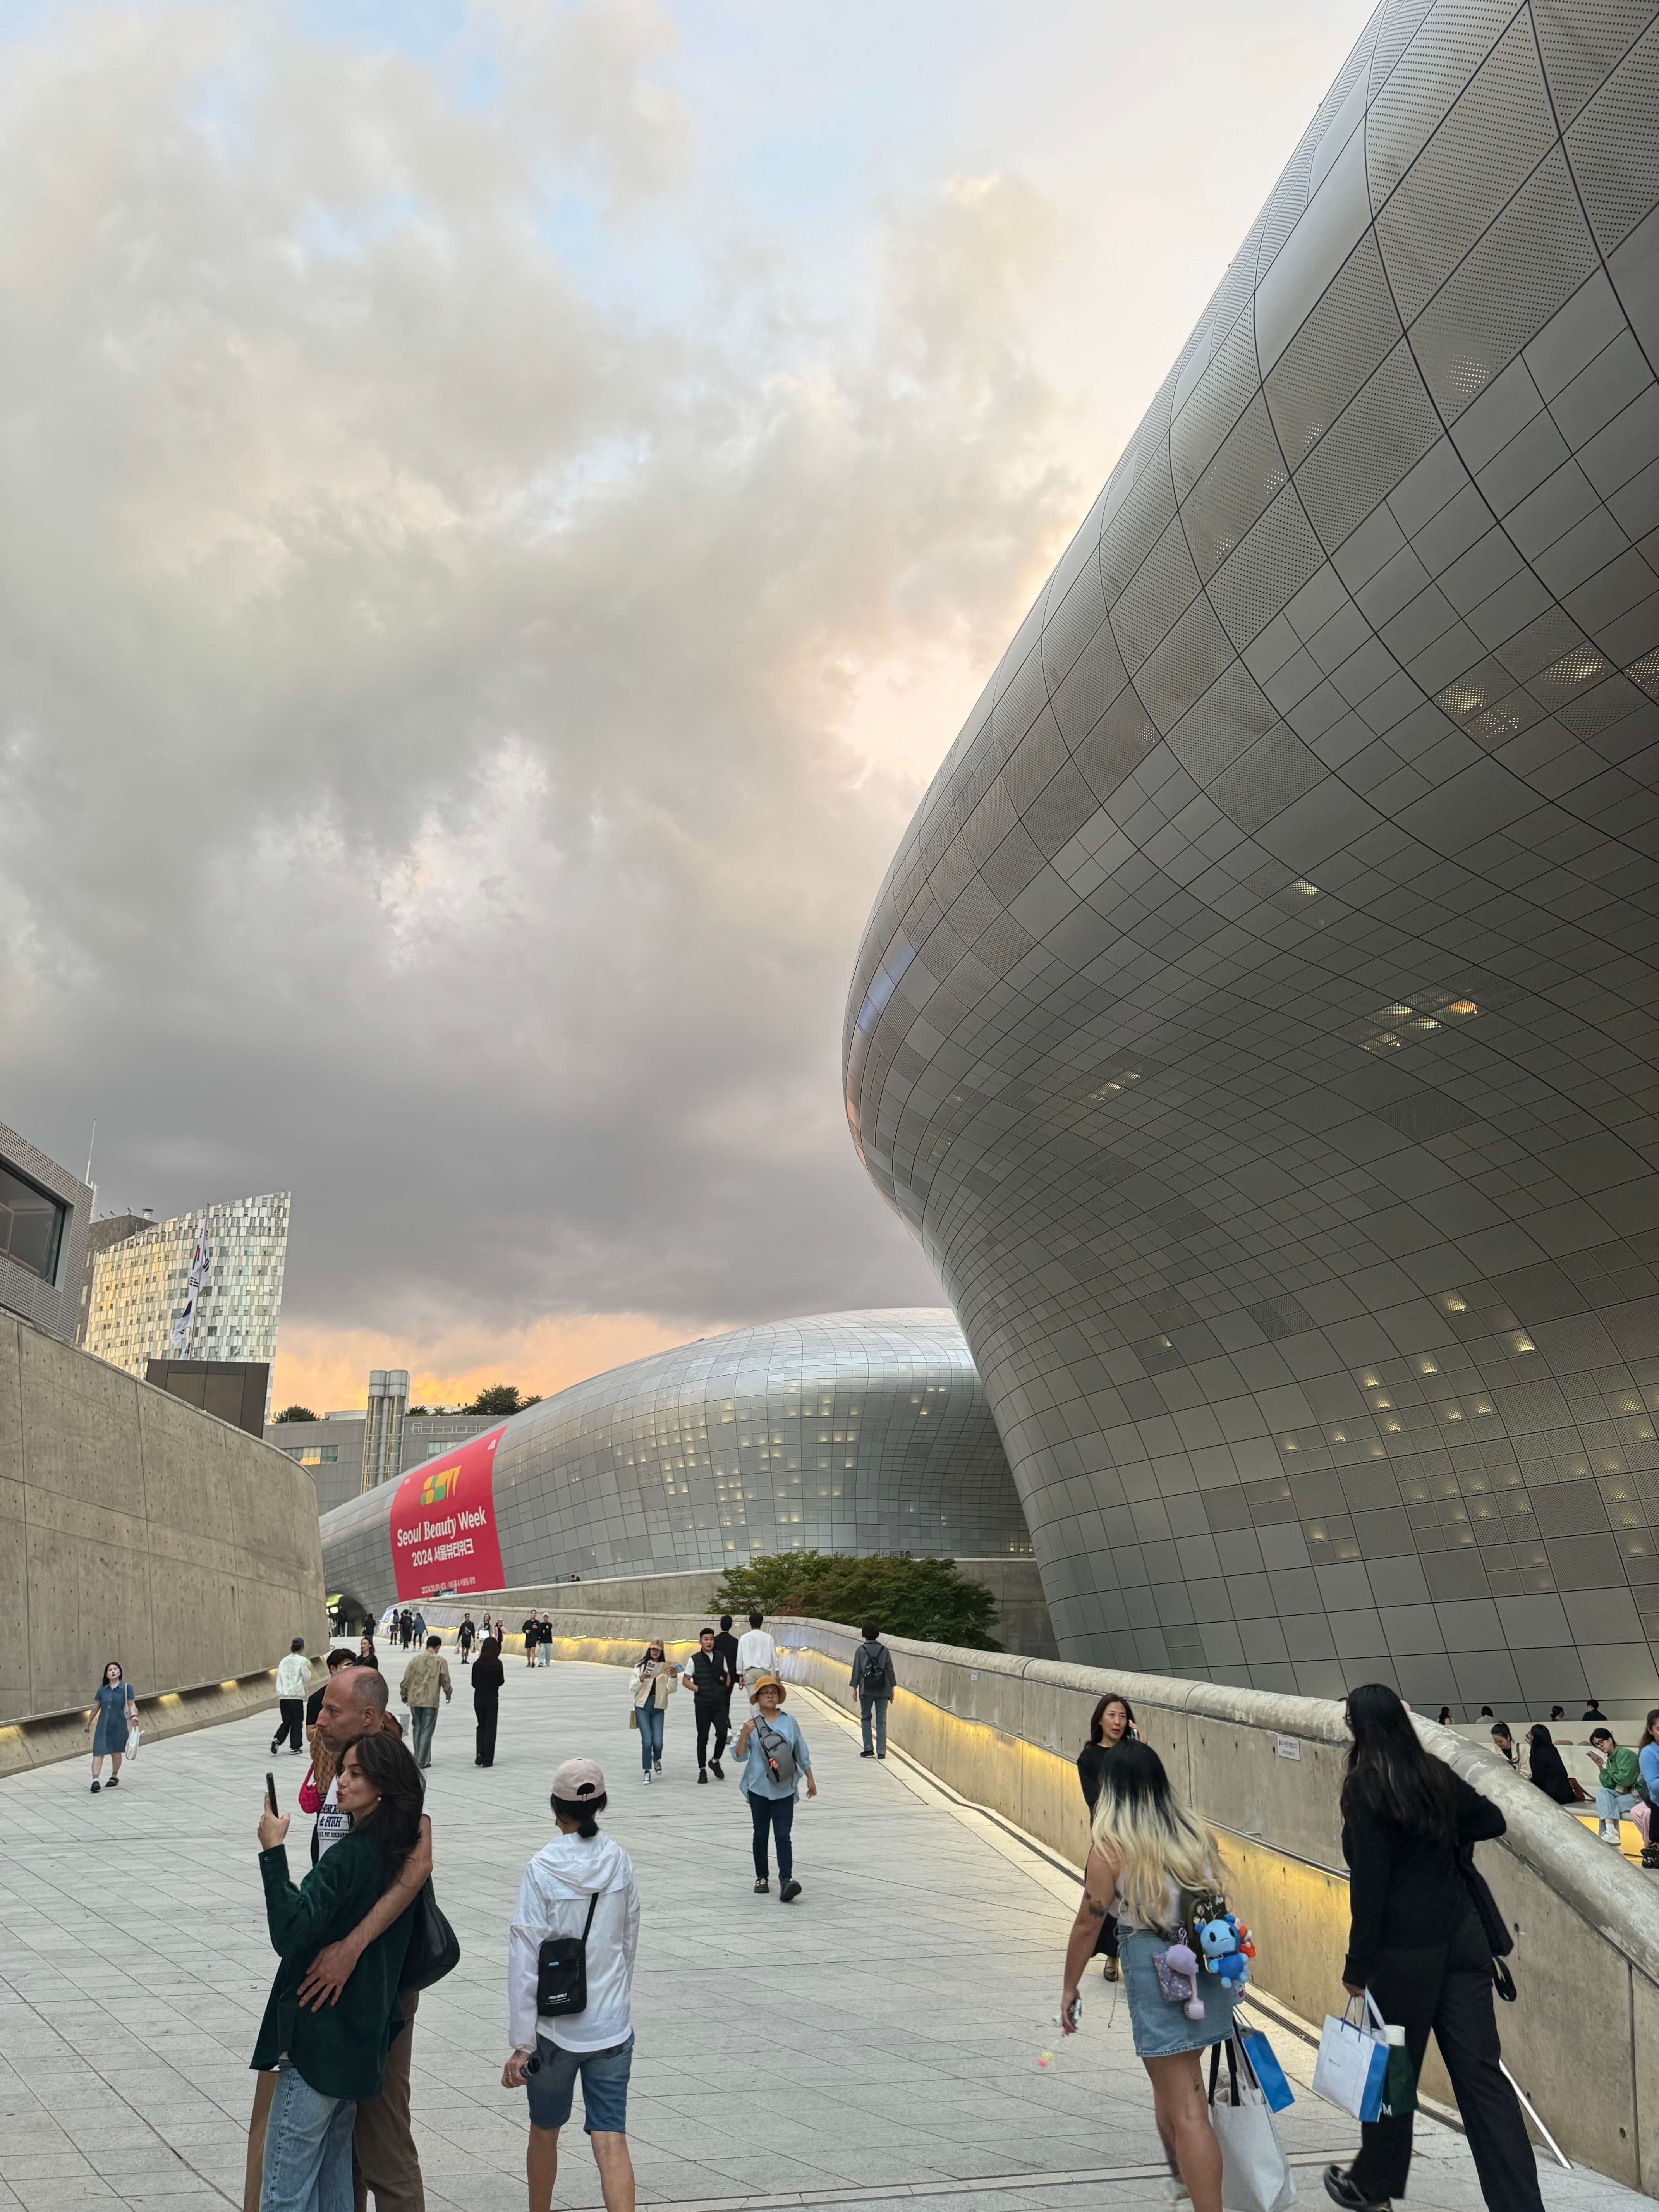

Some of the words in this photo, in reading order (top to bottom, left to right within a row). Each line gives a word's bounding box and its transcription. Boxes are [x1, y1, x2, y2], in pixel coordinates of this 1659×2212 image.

[397, 1522, 421, 1547] Seoul
[423, 1516, 456, 1539] Beauty
[458, 1506, 487, 1530] Week
[412, 1548, 433, 1567] 2024
[434, 1538, 474, 1561] 서울뷰티위크
